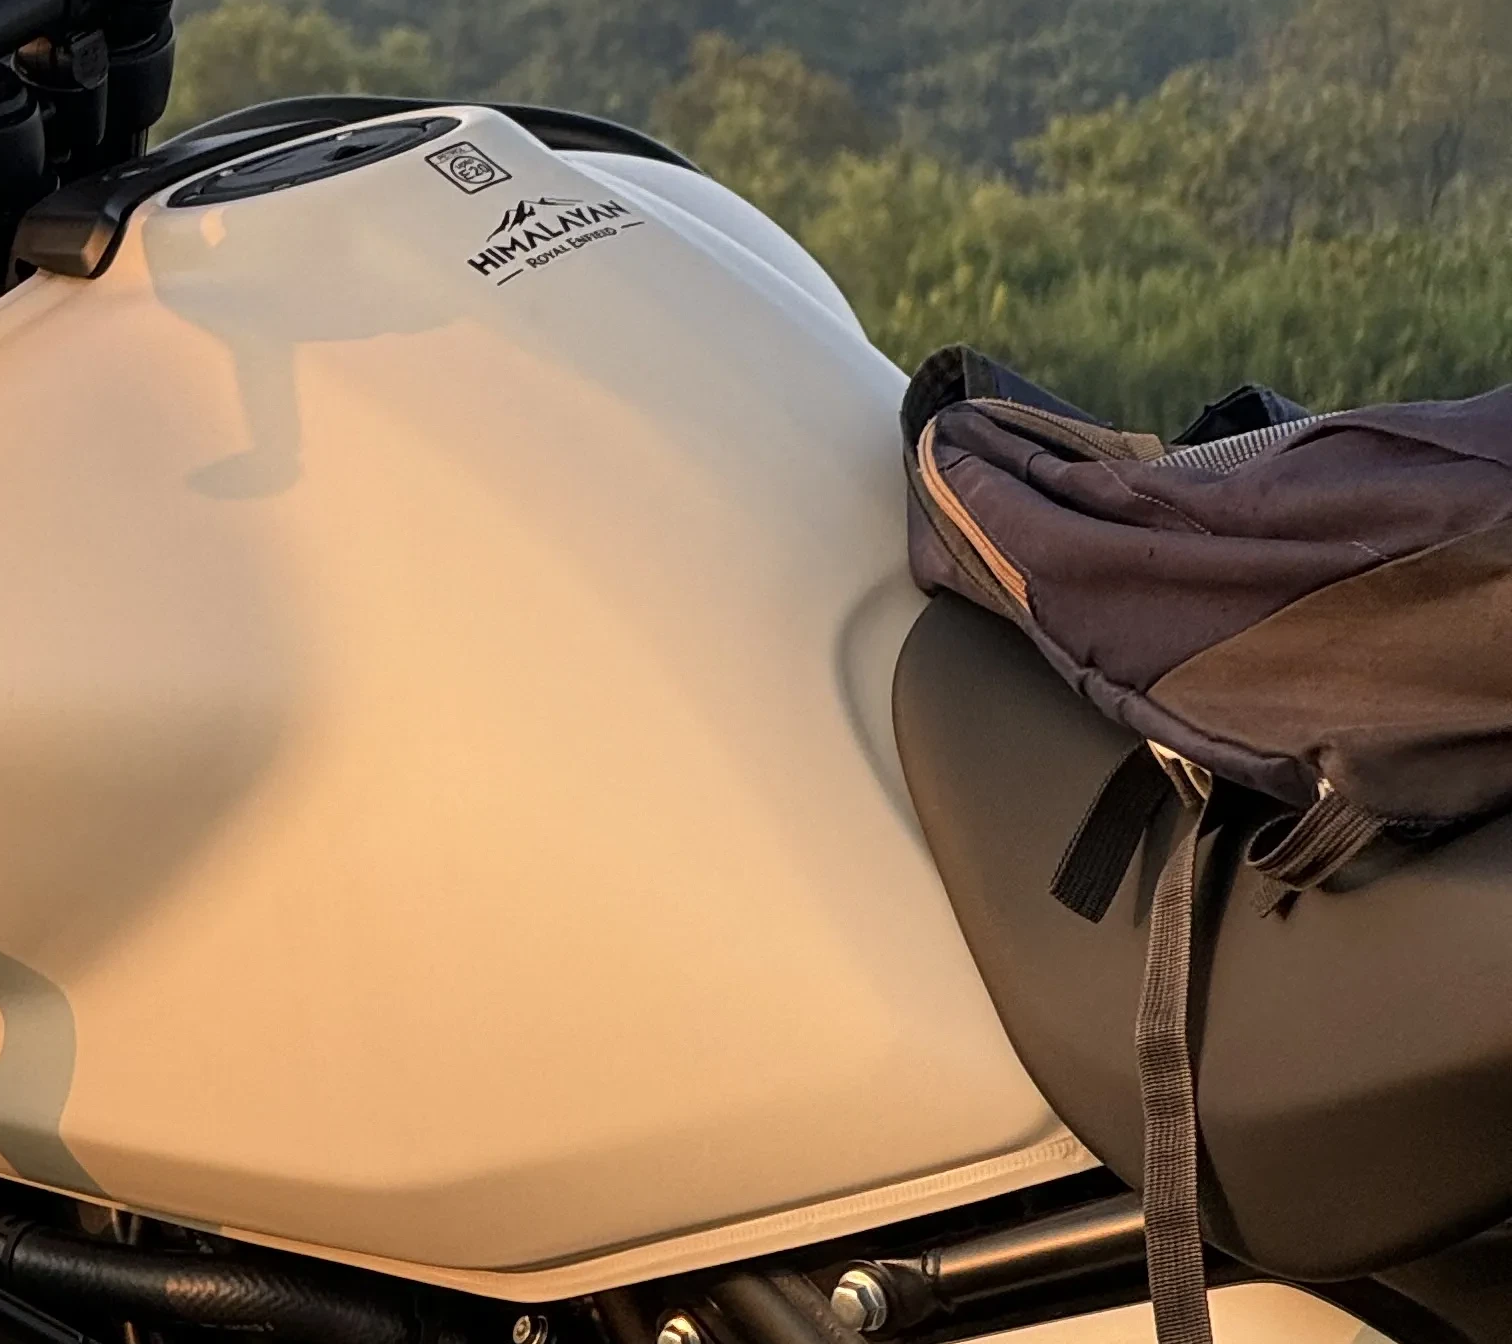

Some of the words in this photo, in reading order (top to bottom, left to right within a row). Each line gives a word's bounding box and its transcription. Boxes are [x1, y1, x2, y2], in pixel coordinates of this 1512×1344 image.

[467, 199, 631, 276] HIMALAYAN
[525, 244, 572, 269] ROYAL
[566, 227, 618, 250] ENFIELD
